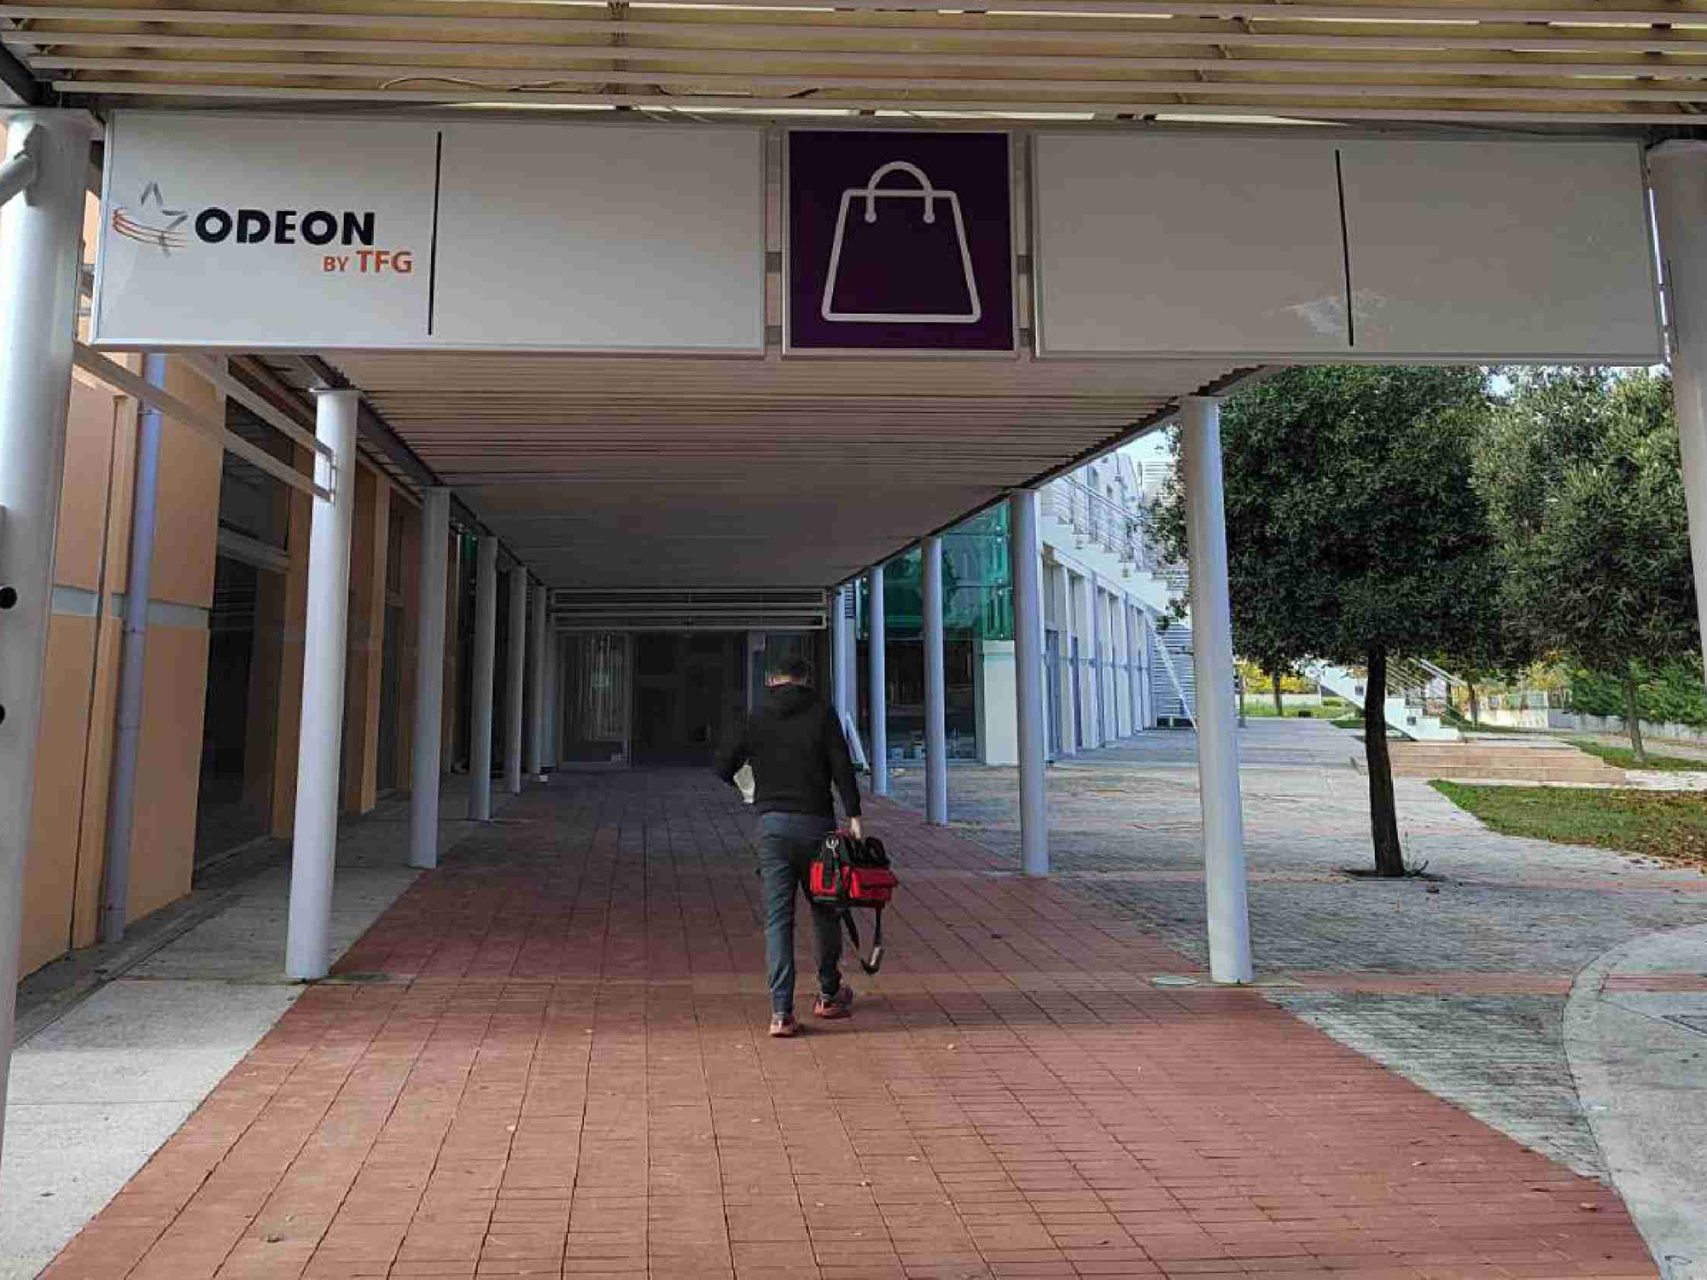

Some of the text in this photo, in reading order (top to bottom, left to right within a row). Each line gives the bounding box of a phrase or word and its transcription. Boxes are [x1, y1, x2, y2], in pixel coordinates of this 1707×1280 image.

[195, 207, 375, 246] ODEON
[324, 249, 412, 273] BY TFG
